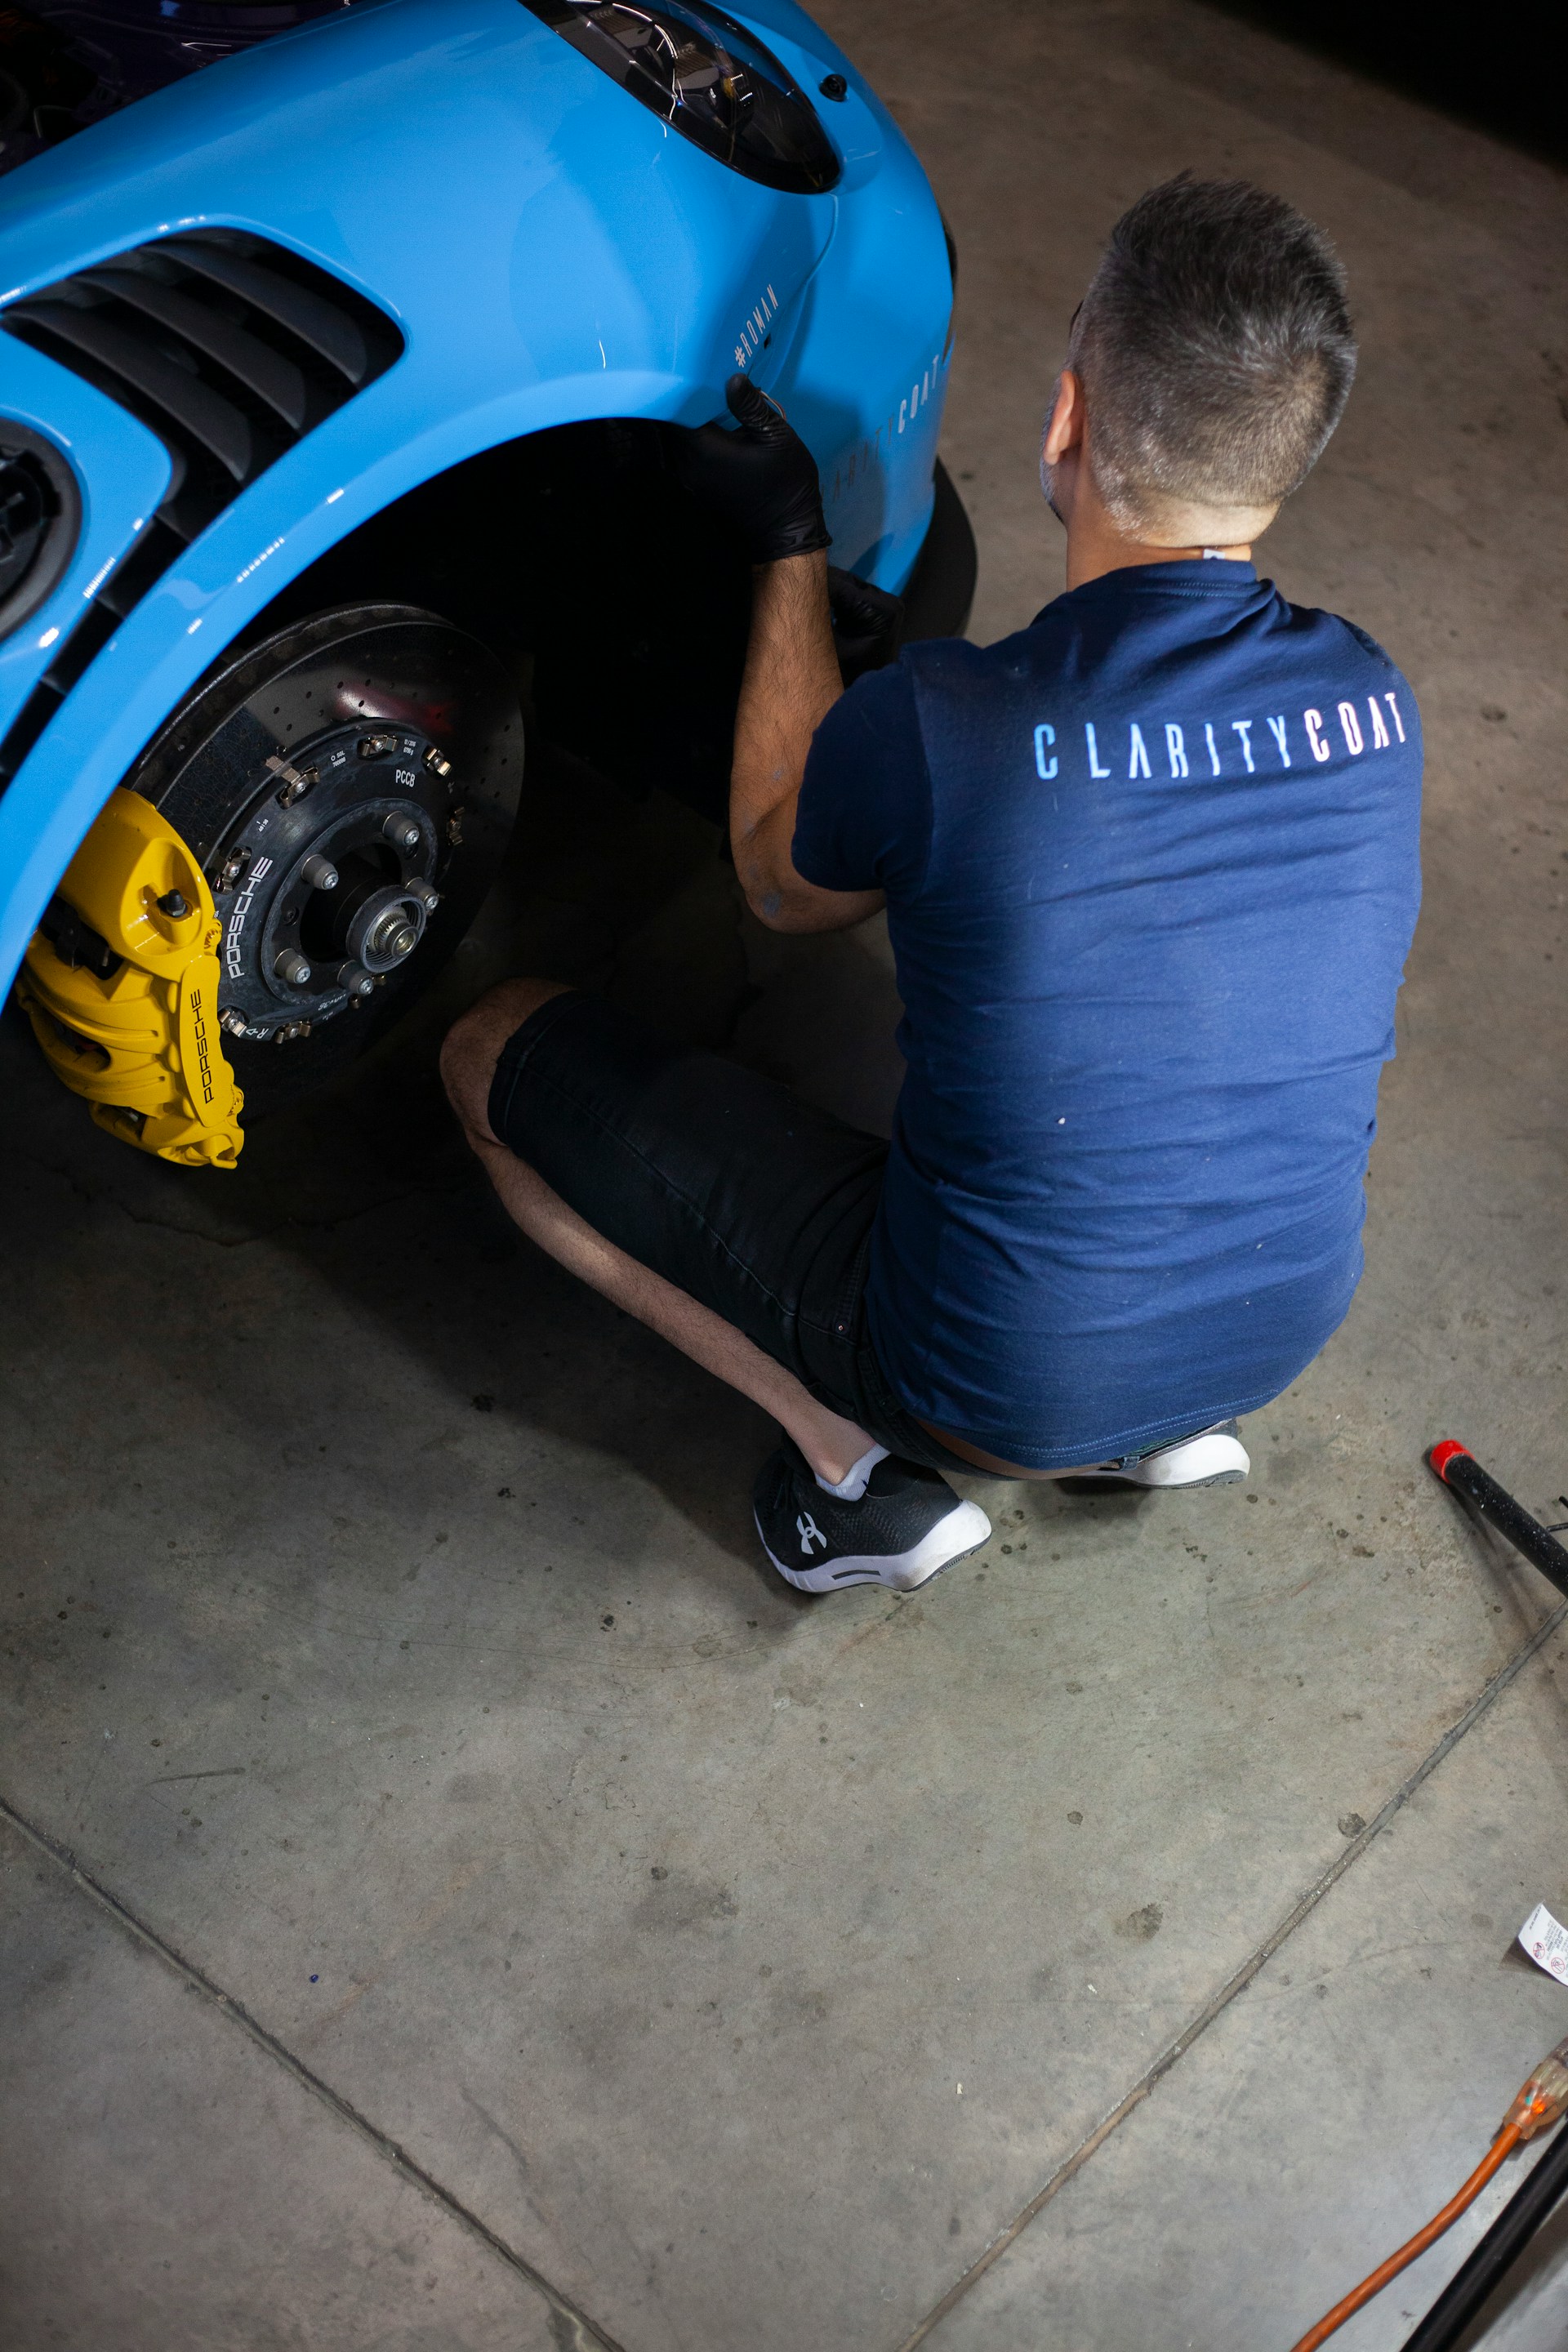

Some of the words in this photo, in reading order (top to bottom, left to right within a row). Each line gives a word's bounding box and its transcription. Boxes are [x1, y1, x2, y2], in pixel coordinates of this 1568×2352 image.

[734, 283, 779, 368] #ROMAN
[395, 768, 416, 788] PCCB
[228, 856, 273, 979] PORSCHE
[190, 988, 215, 1104] PORSCHE
